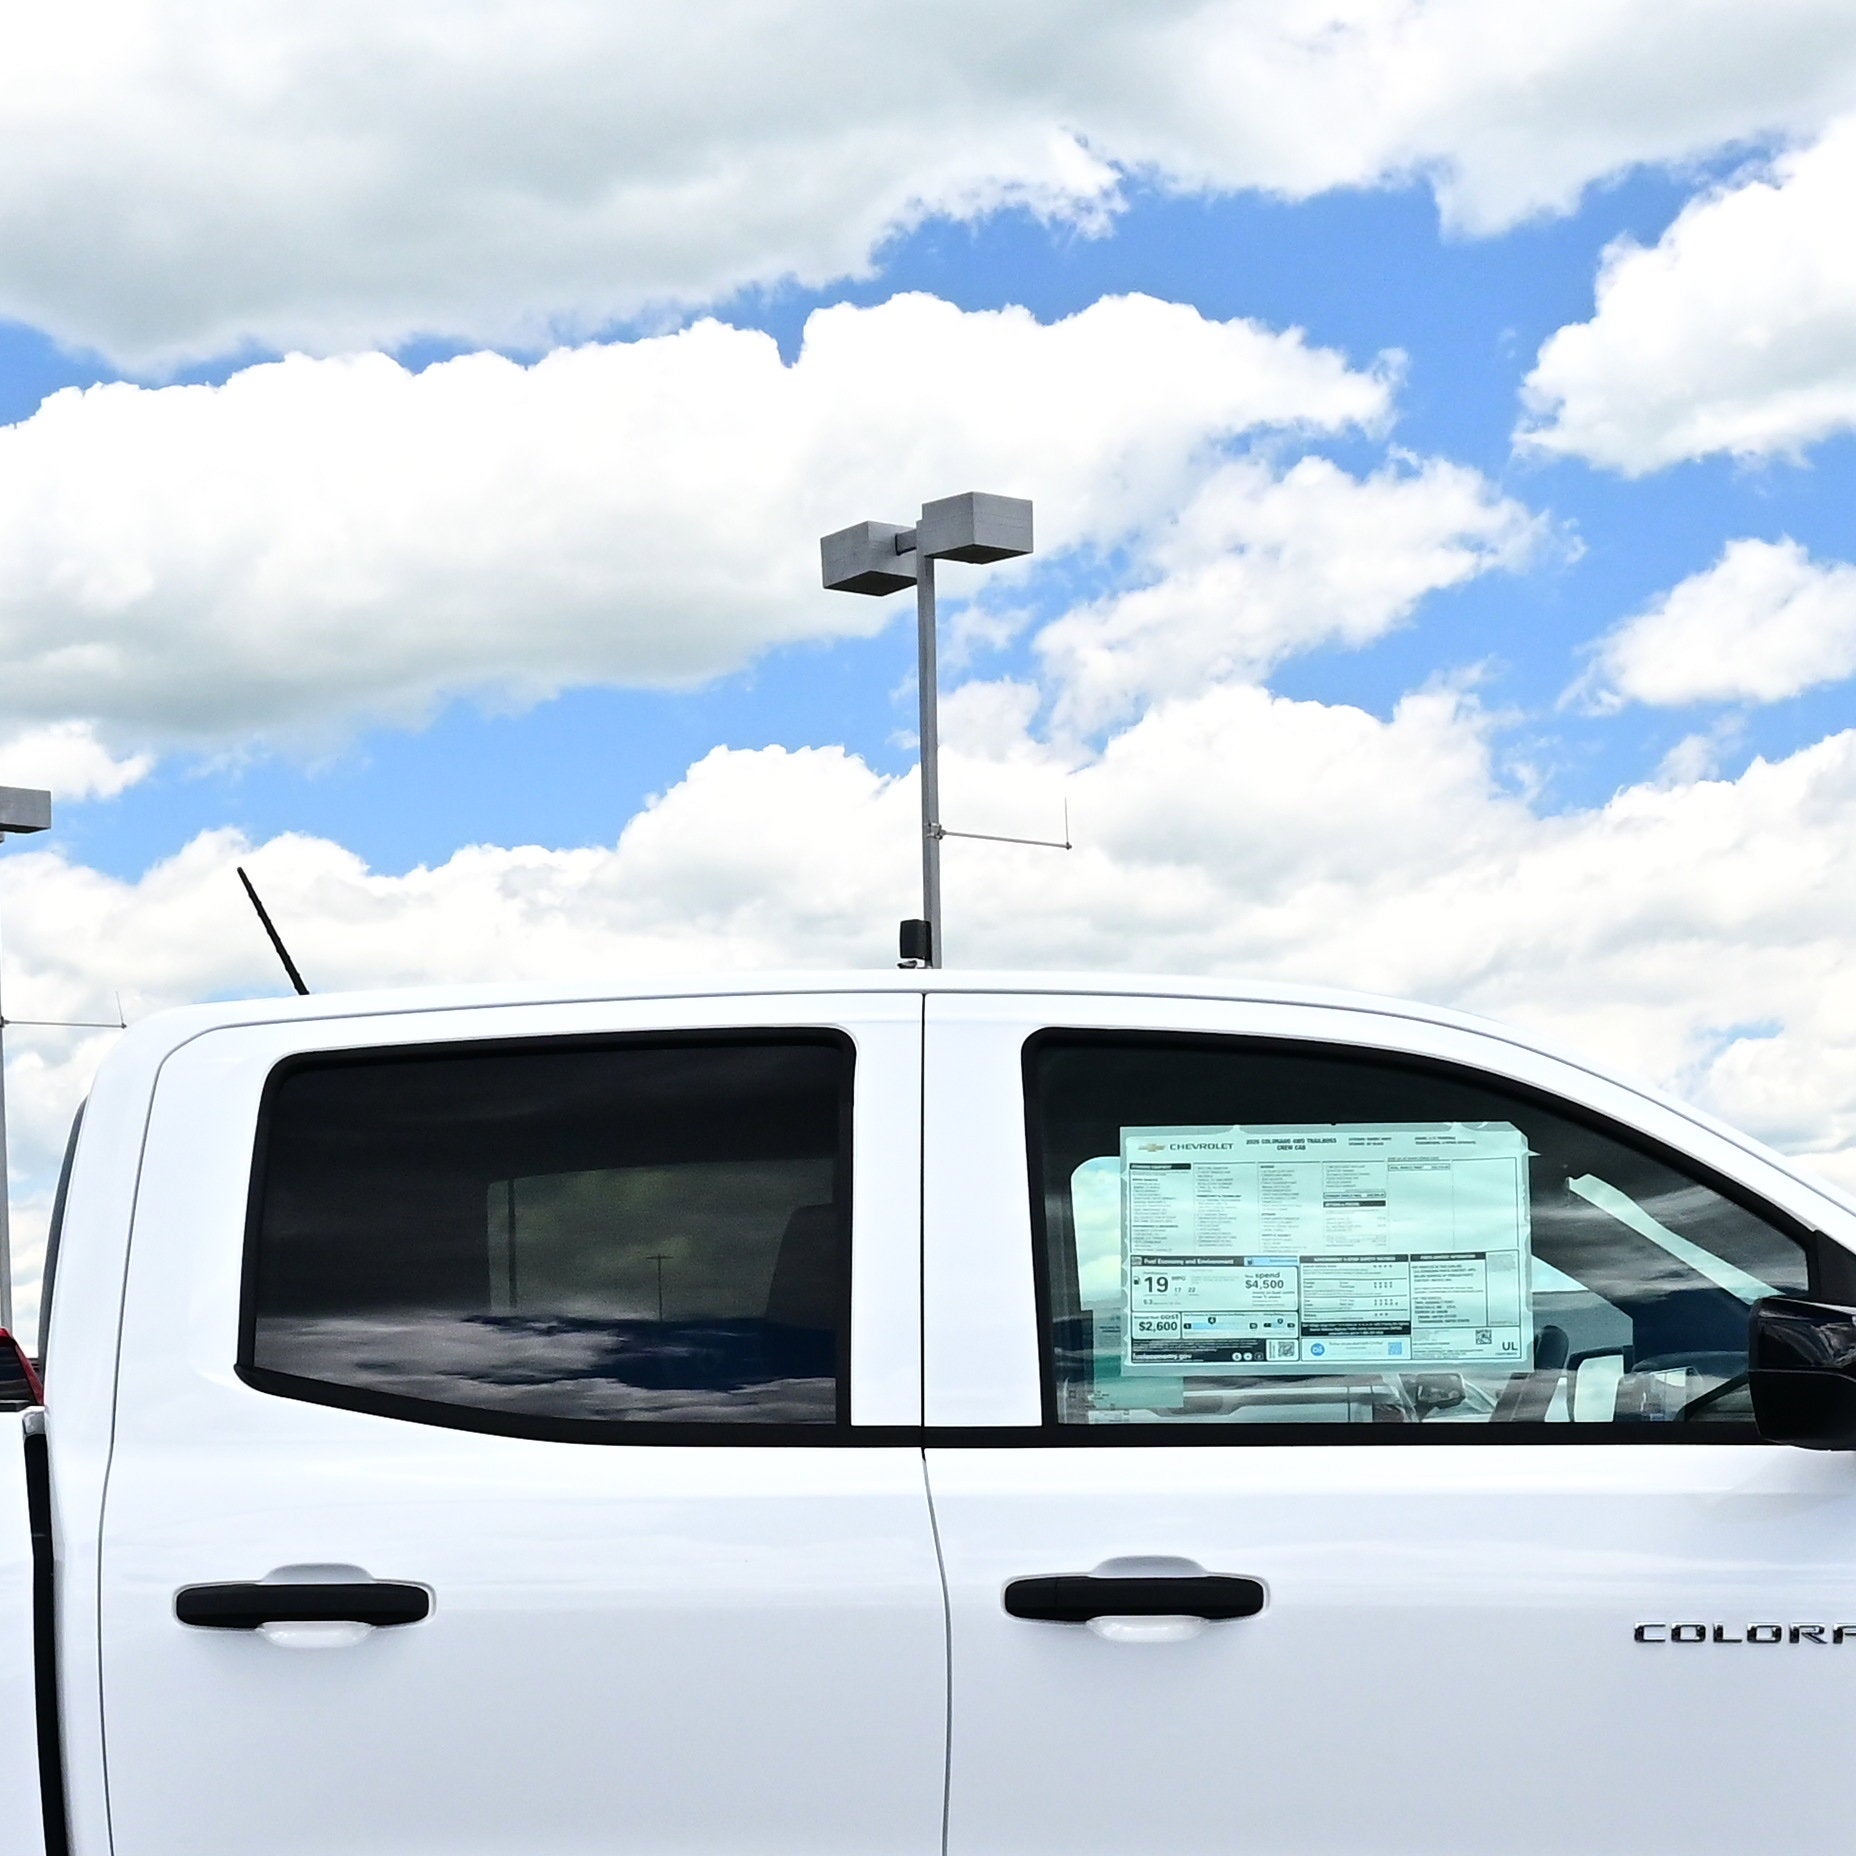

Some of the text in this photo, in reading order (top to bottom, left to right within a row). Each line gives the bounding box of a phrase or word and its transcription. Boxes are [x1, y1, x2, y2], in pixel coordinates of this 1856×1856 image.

[1169, 1143, 1234, 1151] CHEVROLET
[1144, 1276, 1169, 1293] 19
[1245, 1279, 1284, 1290] $4,500
[1139, 1321, 1178, 1332] $2,600
[1502, 1341, 1519, 1351] UL
